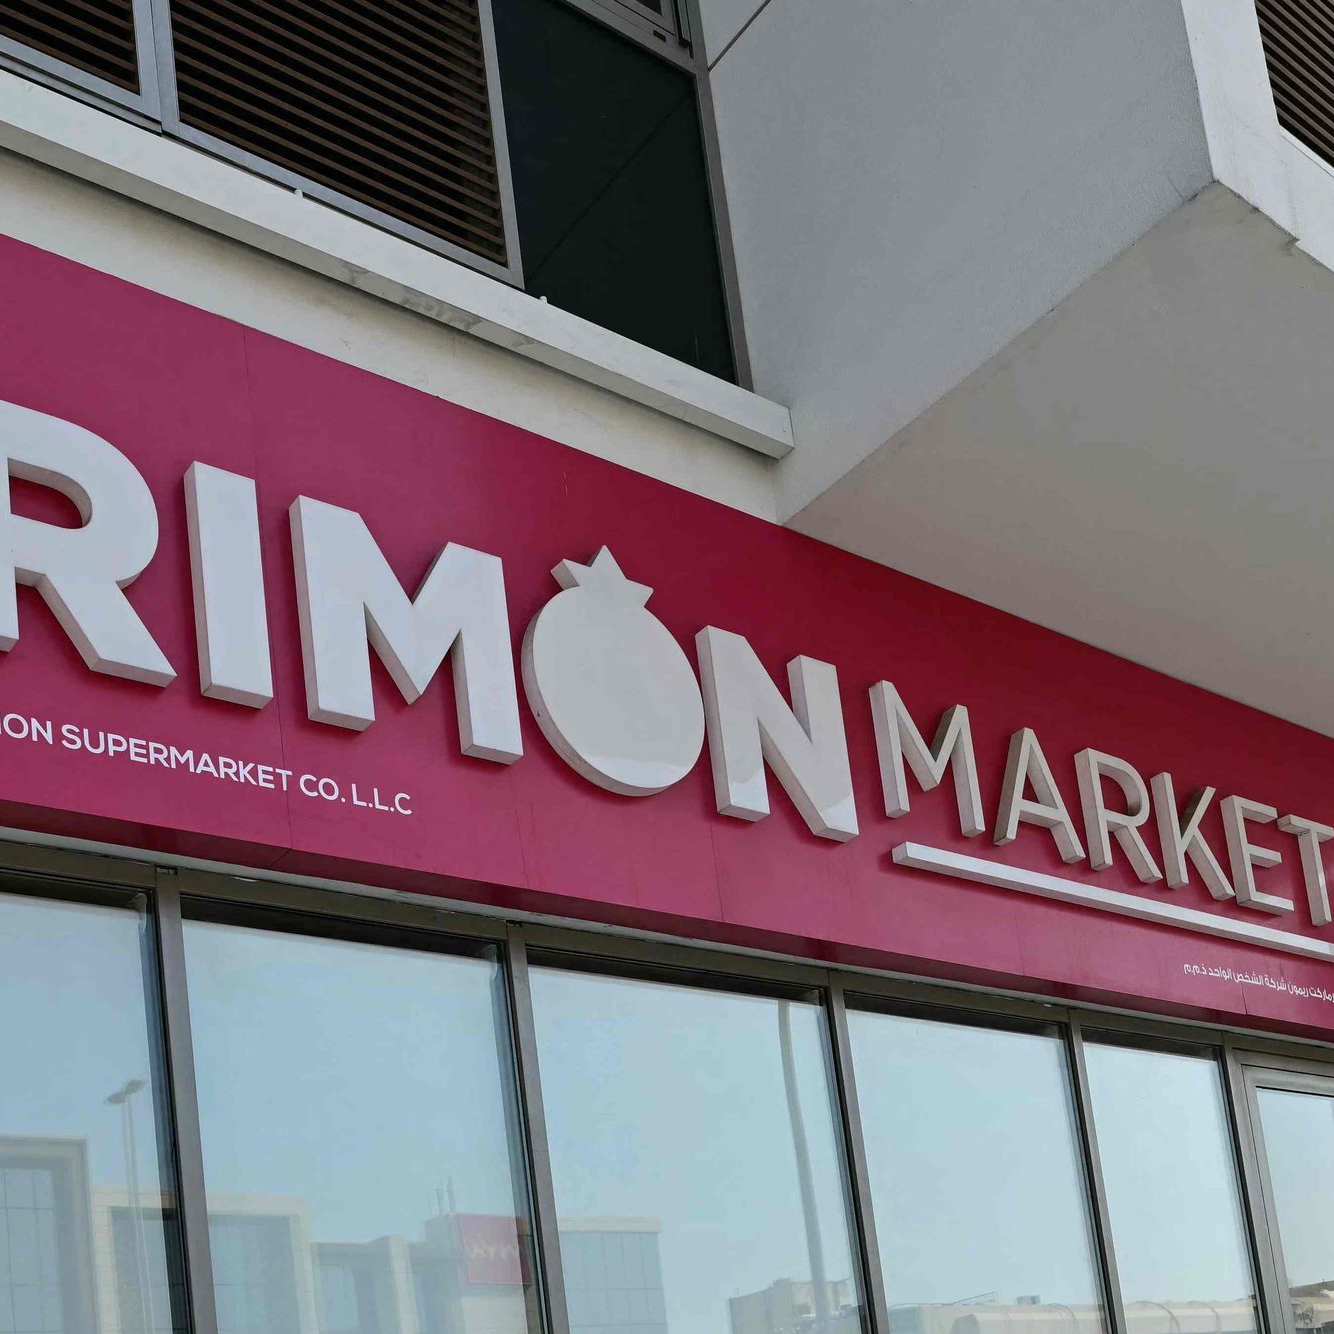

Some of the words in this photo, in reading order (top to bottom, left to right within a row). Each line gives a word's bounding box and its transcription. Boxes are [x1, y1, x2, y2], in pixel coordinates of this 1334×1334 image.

[61, 724, 292, 791] SUPERMARKET
[299, 774, 346, 803] CO.
[351, 784, 412, 815] L.L.C
[869, 679, 1334, 927] MARKET
[1208, 965, 1232, 981] الواحد
[1234, 970, 1264, 986] الشخص
[1265, 974, 1287, 991] شركة
